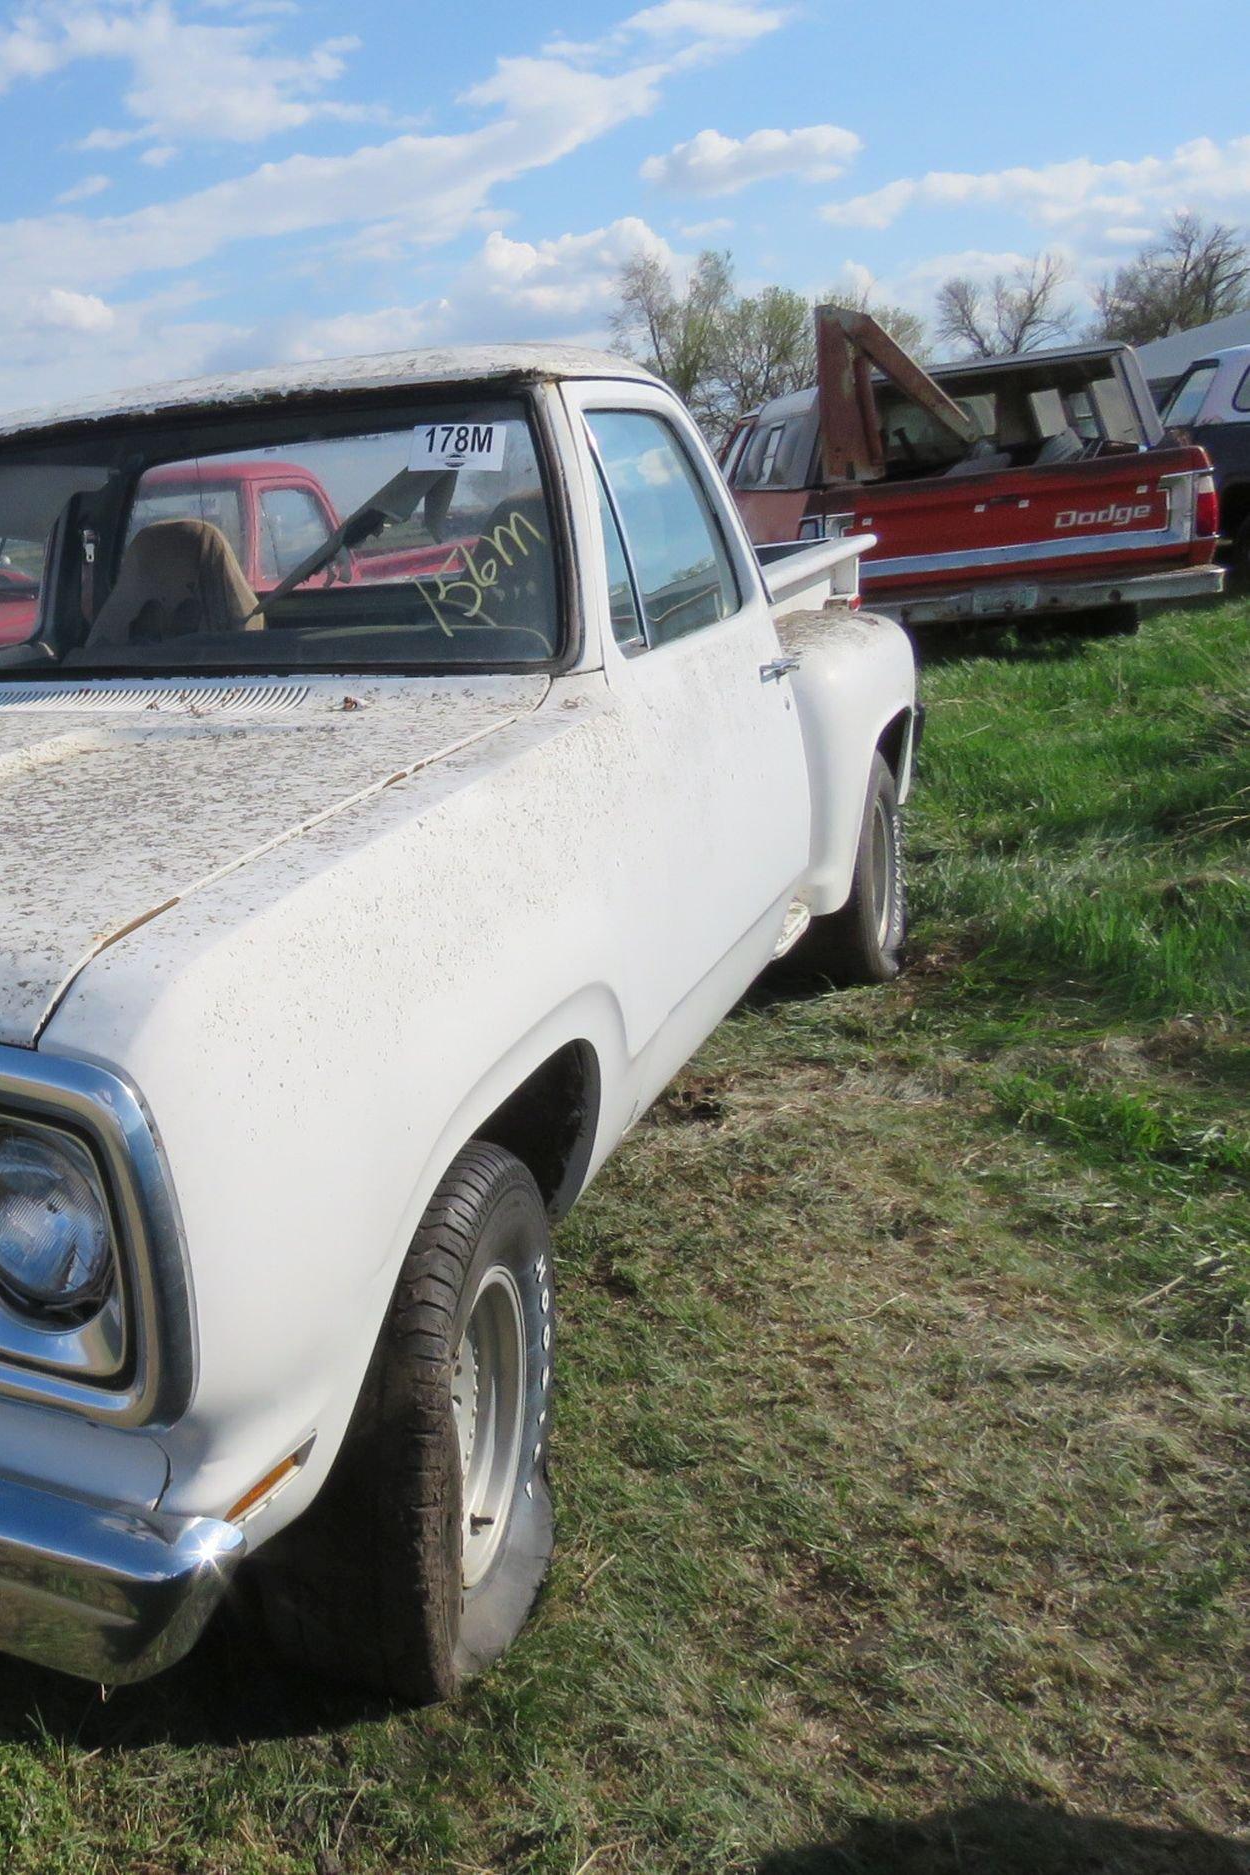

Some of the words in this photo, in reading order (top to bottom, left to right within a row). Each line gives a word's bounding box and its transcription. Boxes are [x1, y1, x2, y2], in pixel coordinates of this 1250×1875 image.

[425, 426, 494, 454] 178M
[1055, 504, 1151, 528] Dodge
[413, 512, 546, 638] 156M
